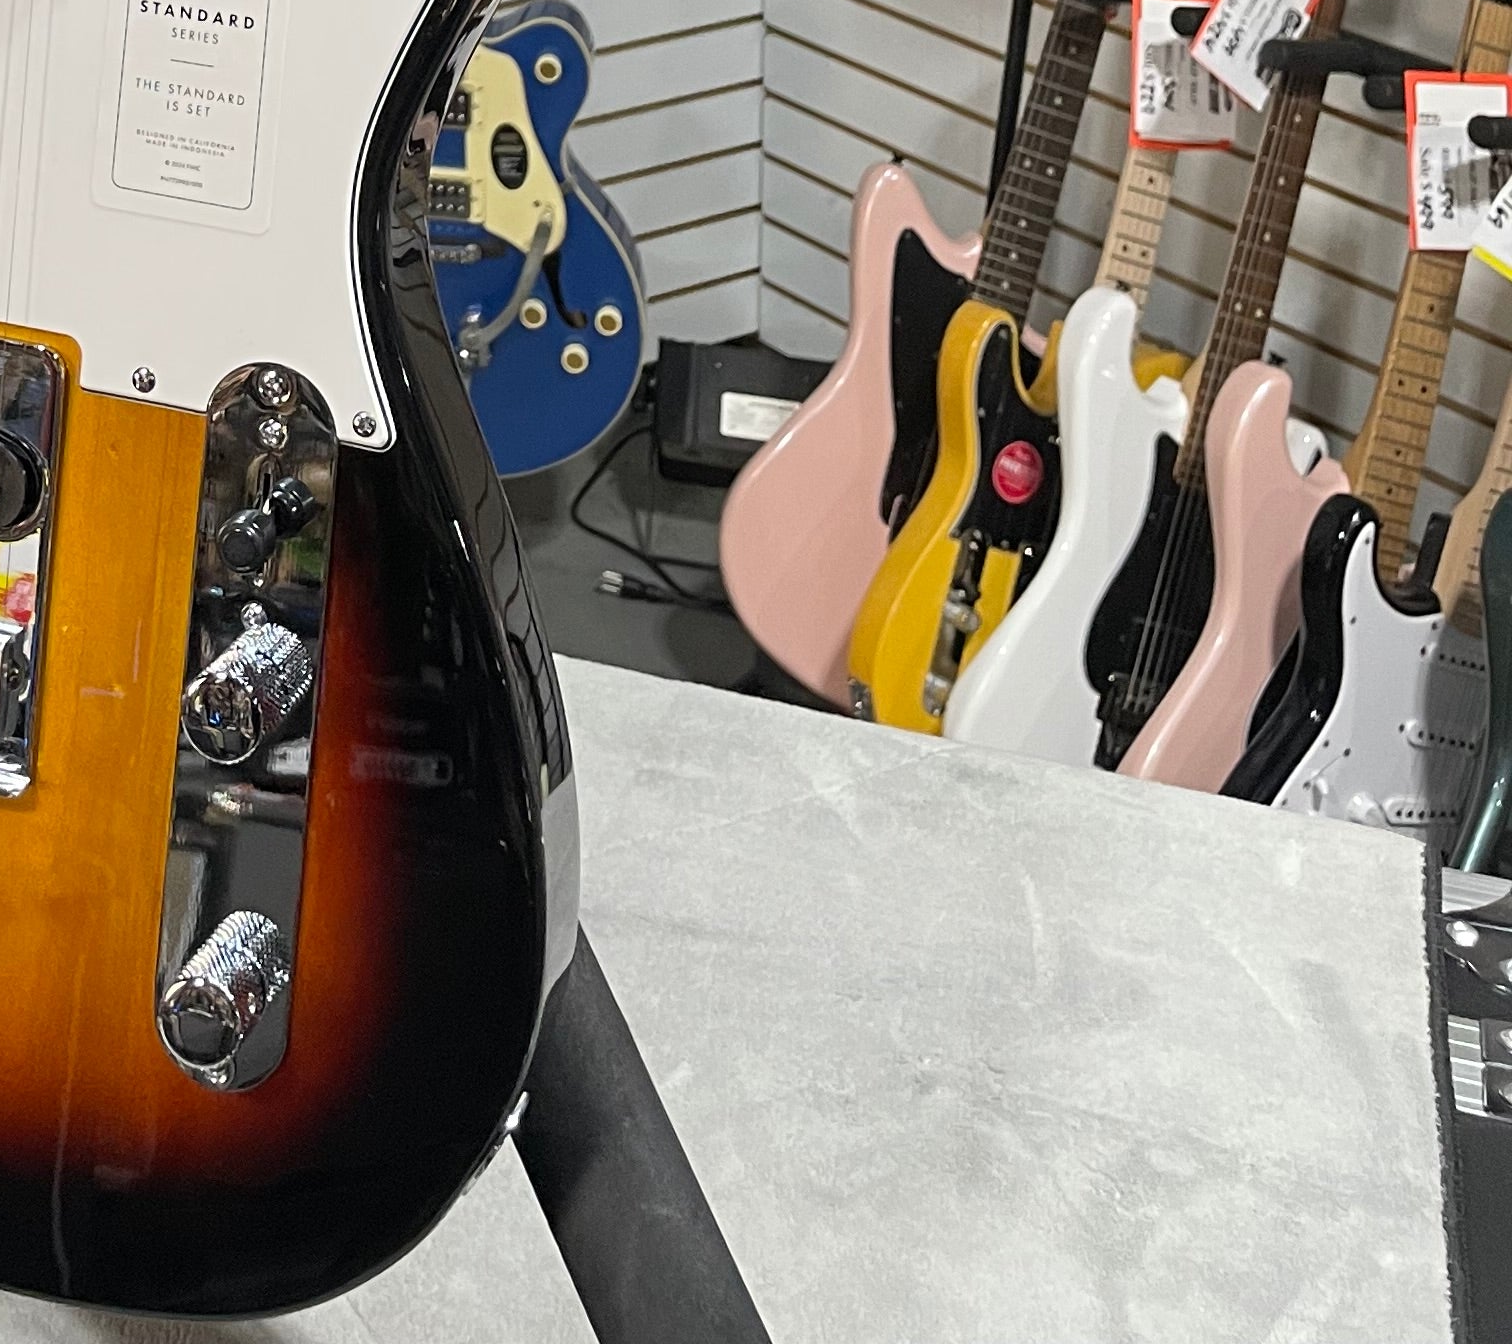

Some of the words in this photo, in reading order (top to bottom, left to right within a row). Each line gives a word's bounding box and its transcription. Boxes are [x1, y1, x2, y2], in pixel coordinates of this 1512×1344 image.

[140, 0, 255, 30] STANDARD
[171, 27, 220, 45] SERIES
[135, 77, 161, 92] THE
[168, 83, 246, 107] STANDARD
[166, 101, 179, 113] IS
[187, 104, 211, 118] SET
